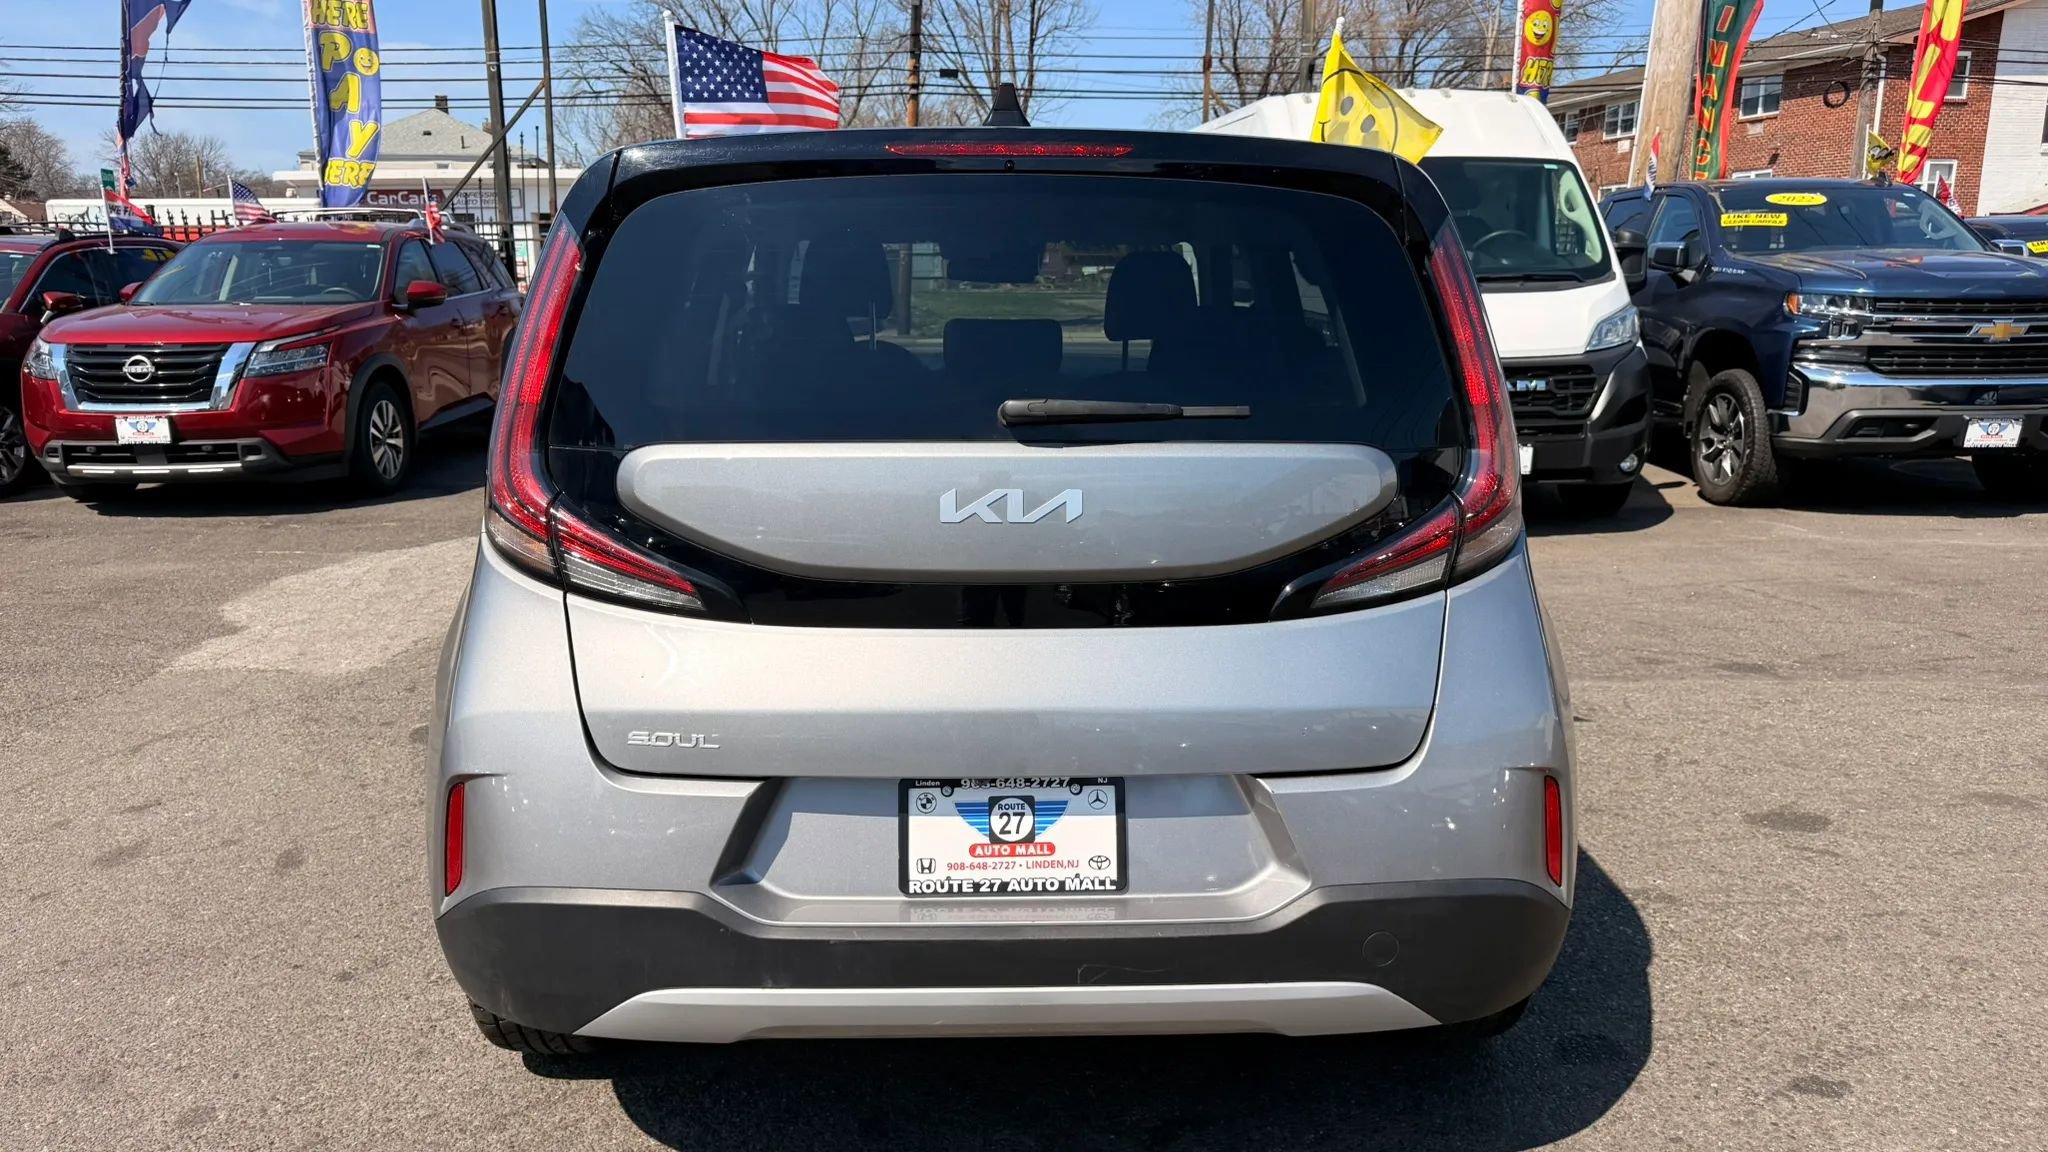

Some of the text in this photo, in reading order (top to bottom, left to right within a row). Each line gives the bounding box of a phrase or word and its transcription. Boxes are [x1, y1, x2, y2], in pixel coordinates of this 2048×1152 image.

[311, 0, 369, 29] HERE
[324, 158, 377, 187] ERE
[1505, 379, 1546, 391] AM
[940, 488, 1083, 524] KIA
[627, 731, 720, 749] SOUL
[998, 803, 1026, 811] ROUTE
[999, 812, 1026, 835] 27
[975, 844, 1052, 856] AUTO MALL
[946, 861, 1016, 871] 908-648-2727
[909, 876, 1117, 894] ROUTE 27 AUTO MALL
